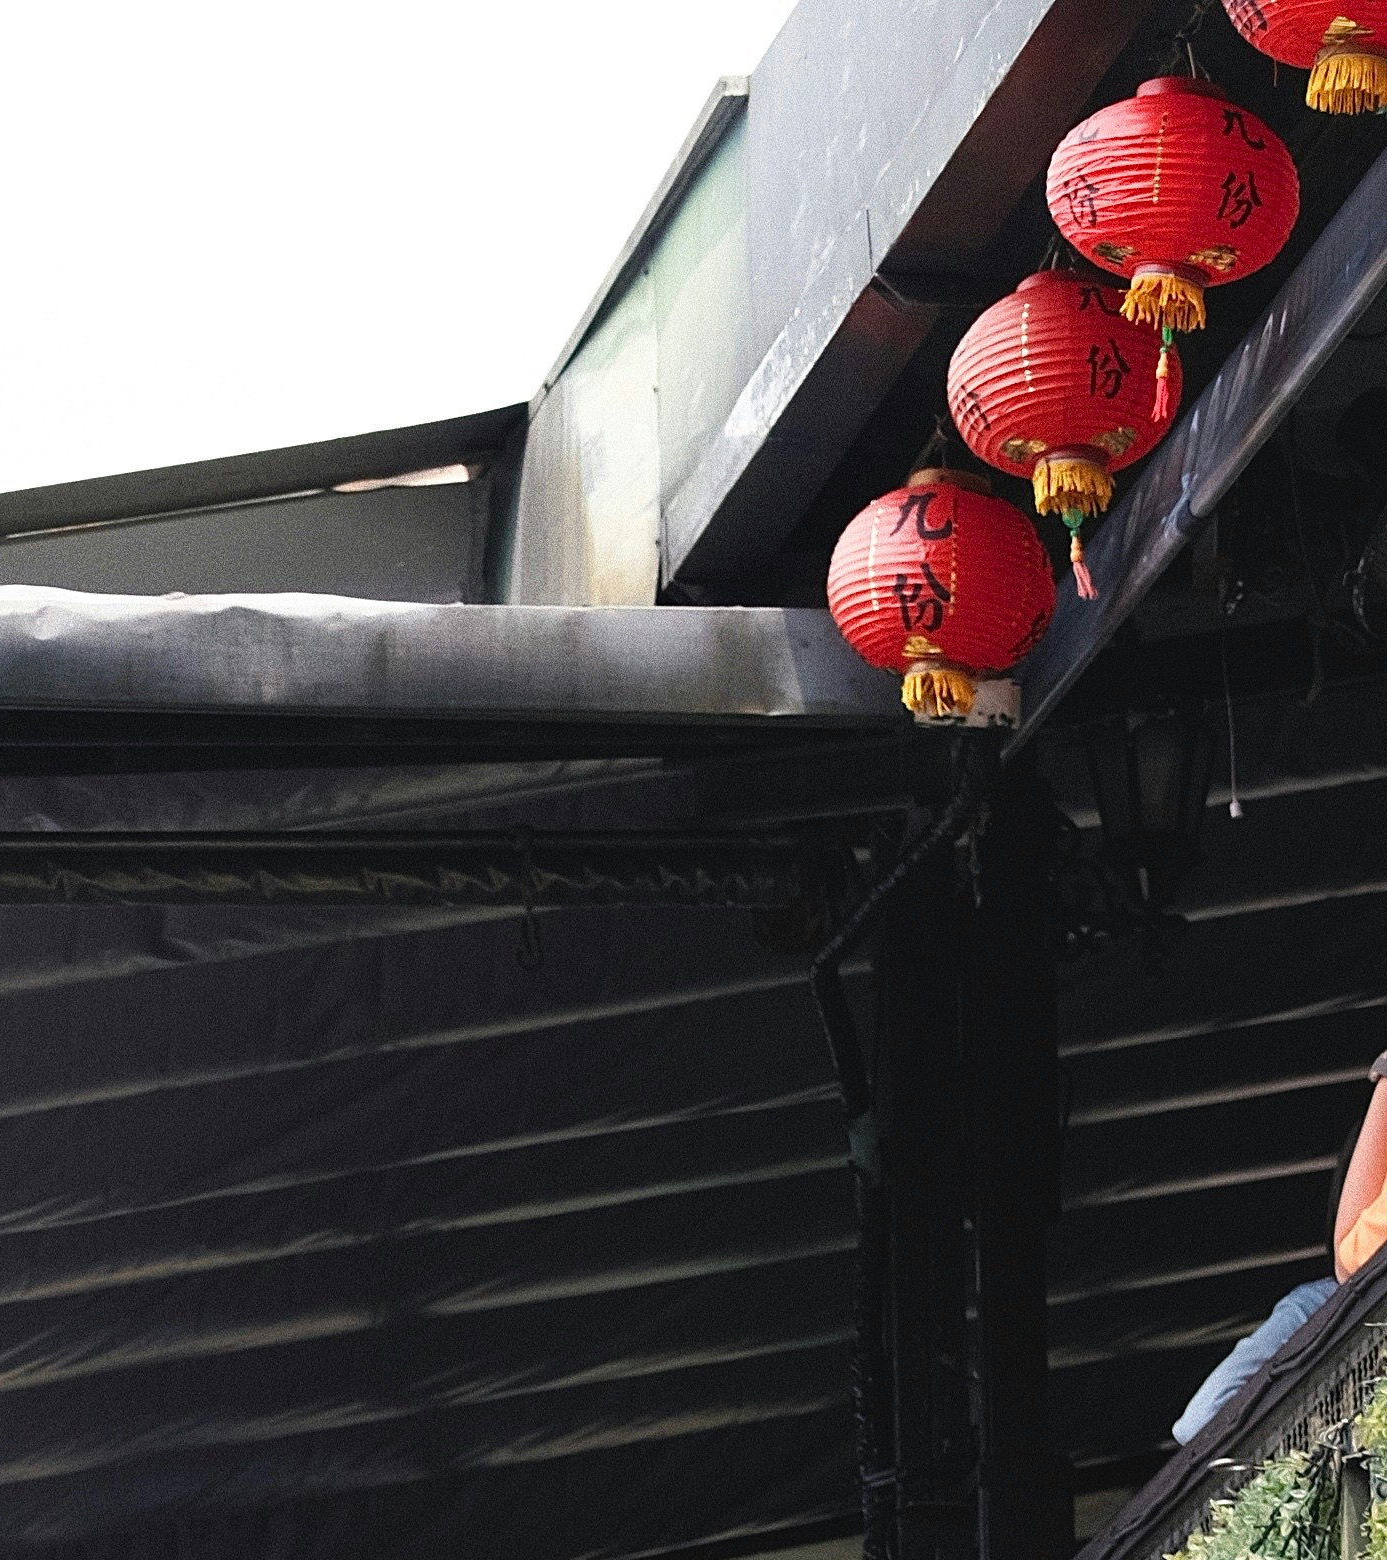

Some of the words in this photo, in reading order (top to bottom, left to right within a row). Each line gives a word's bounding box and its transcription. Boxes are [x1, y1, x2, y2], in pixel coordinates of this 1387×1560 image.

[1217, 108, 1266, 229] 九份
[1079, 285, 1131, 400] 九份
[890, 492, 953, 633] 九份
